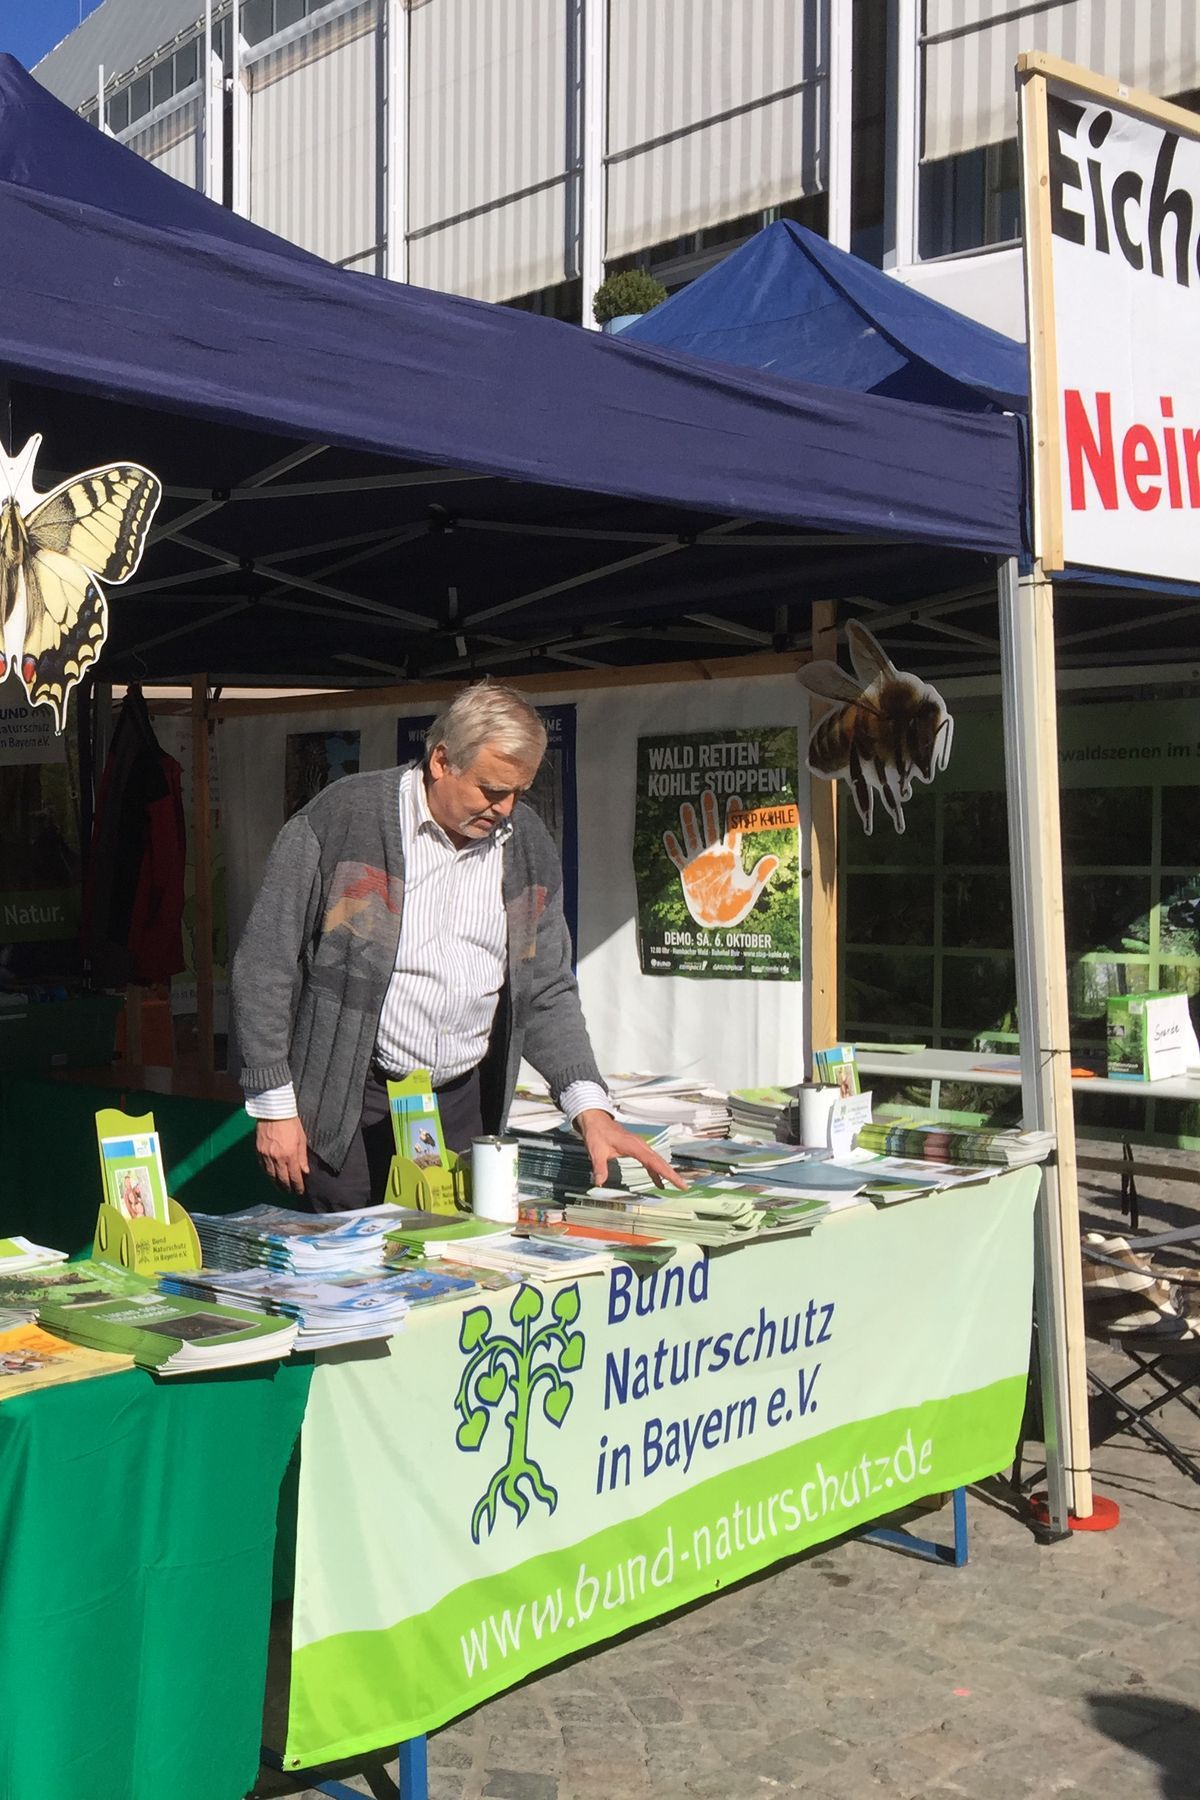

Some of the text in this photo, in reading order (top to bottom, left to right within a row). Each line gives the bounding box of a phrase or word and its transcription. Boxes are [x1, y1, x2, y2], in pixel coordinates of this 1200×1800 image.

[1048, 96, 1200, 288] Eich
[649, 747, 694, 770] WALD
[699, 742, 759, 768] RETTEN
[1058, 745, 1161, 762] waldszenen
[648, 767, 787, 797] KOHLE STOPPEN!
[4, 904, 65, 925] Natur.
[664, 931, 772, 949] DEMO: SA. 6. OKTOBER
[607, 1255, 709, 1325] Bund
[604, 1300, 836, 1410] Naturschutz
[596, 1363, 822, 1495] in Bayern e.V.
[460, 1427, 934, 1679] www.bund-naturschutz.de
